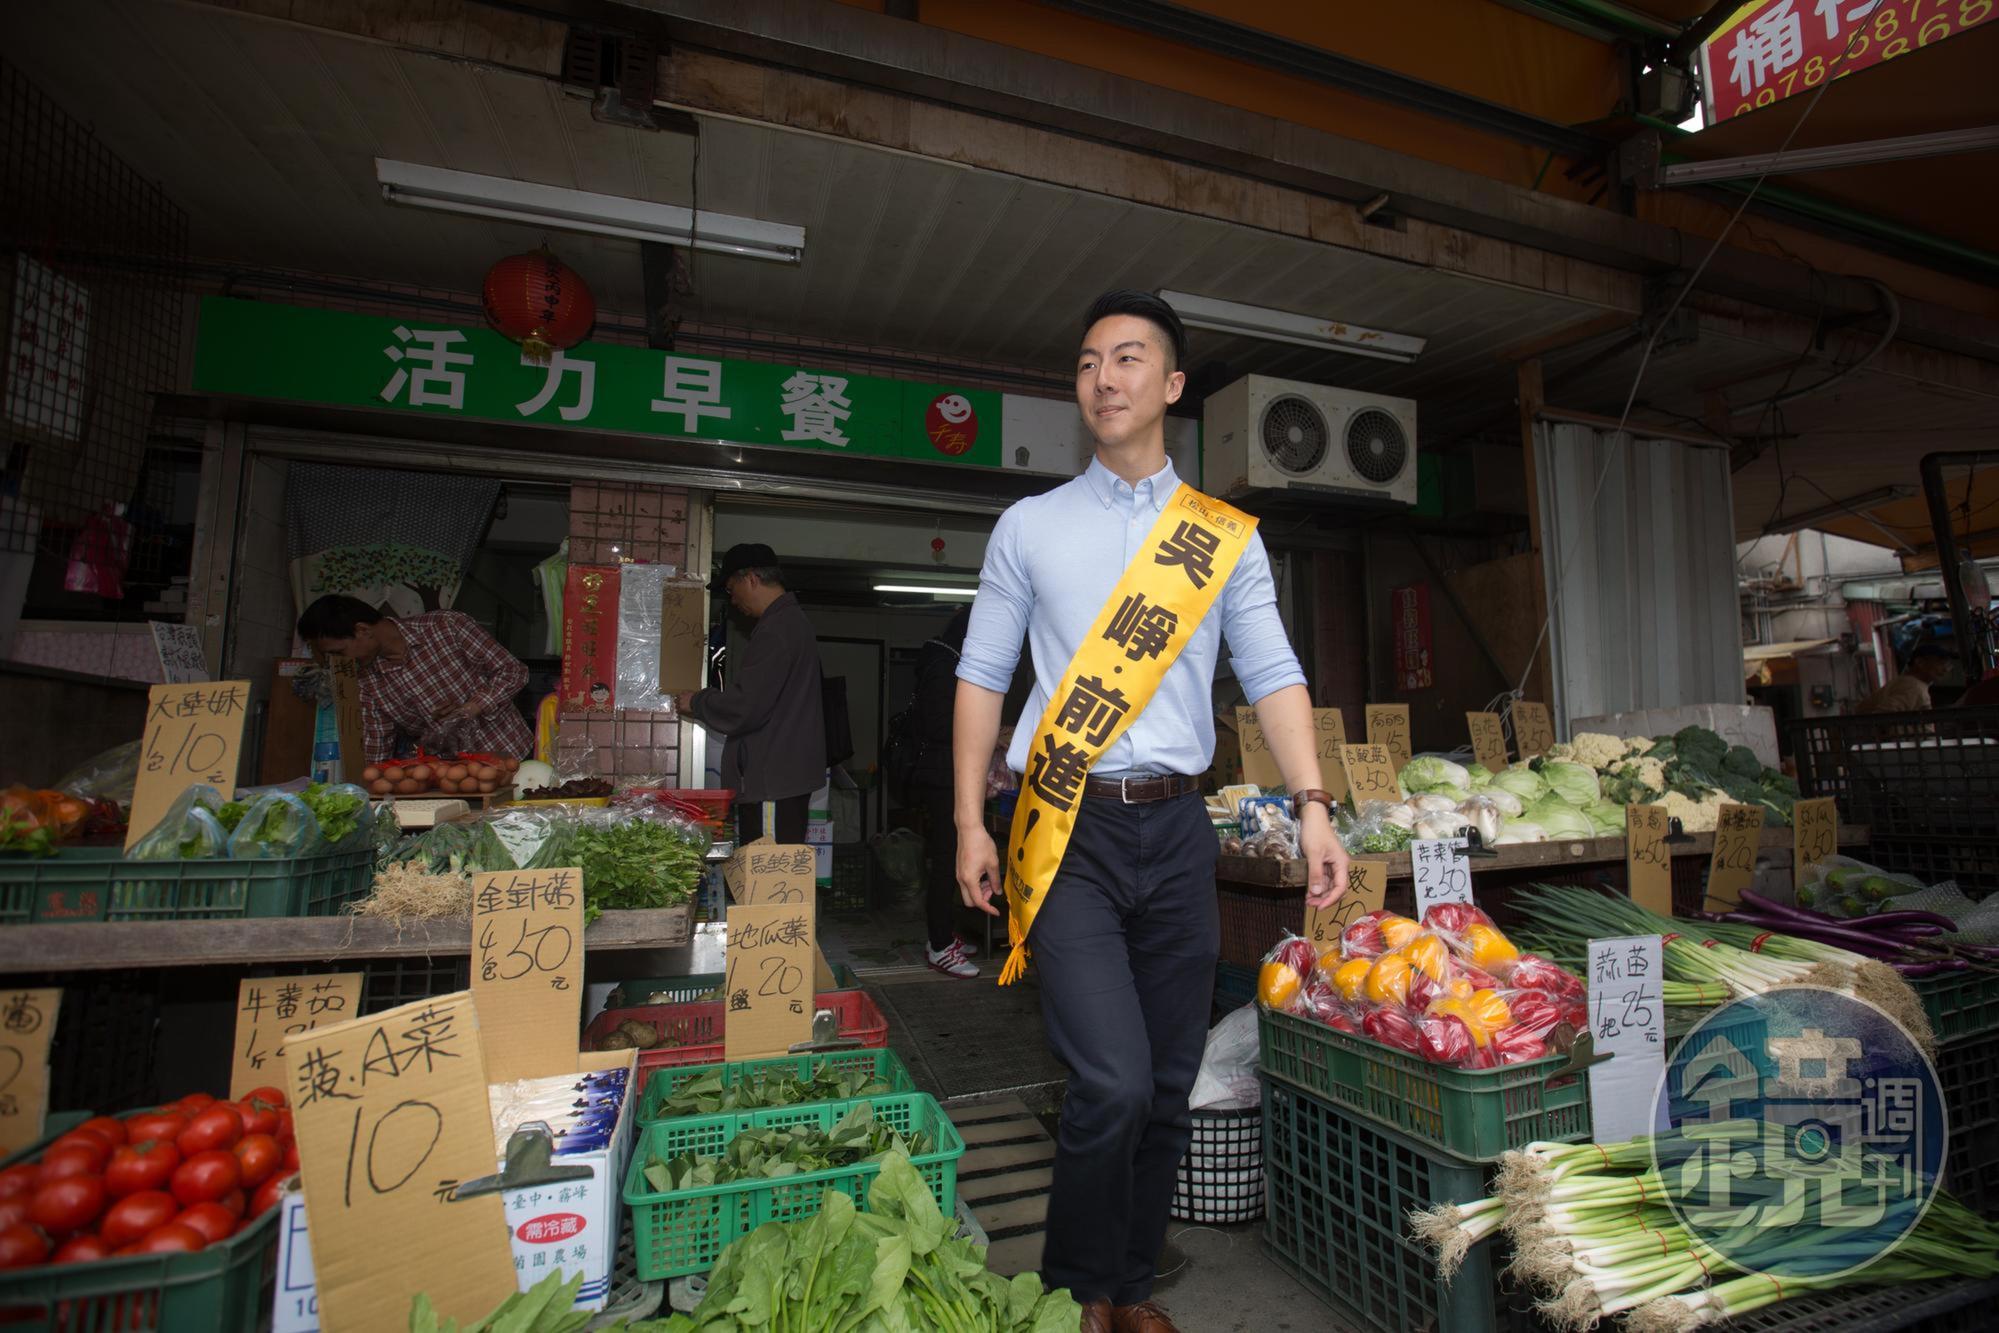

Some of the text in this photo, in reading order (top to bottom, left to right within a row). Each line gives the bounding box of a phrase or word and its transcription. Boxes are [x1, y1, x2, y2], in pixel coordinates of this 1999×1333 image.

[379, 325, 853, 448] 活力早餐
[727, 916, 809, 950] 地瓜葉
[525, 1217, 579, 1241] 需冷藏
